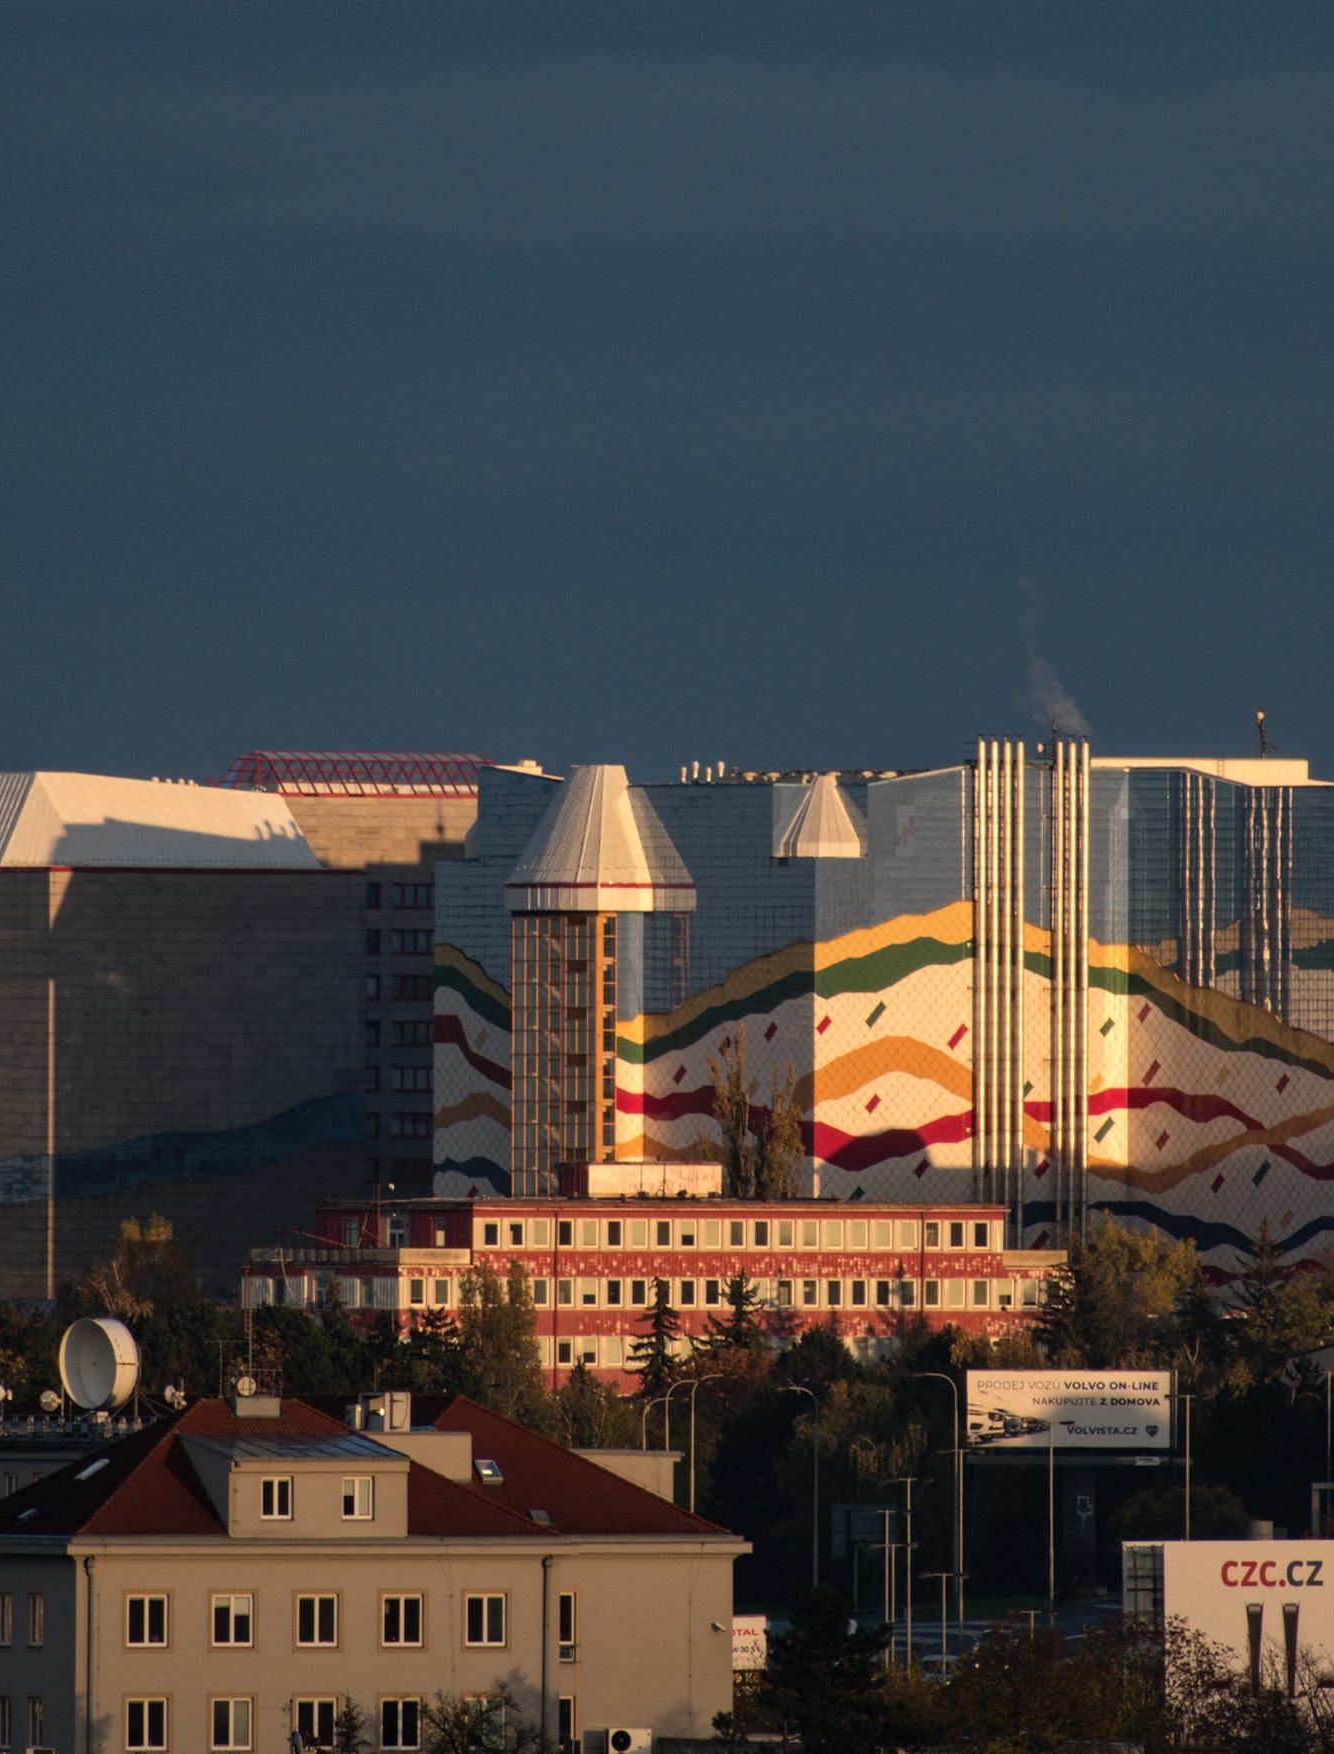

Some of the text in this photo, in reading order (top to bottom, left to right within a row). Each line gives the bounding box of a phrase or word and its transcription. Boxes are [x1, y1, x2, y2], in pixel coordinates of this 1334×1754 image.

[977, 1378, 1159, 1391] PRODEJ VOZŮ VOLVO ON-LINE
[1032, 1397, 1160, 1407] NAKUPUJTE Z DOMOVA
[1066, 1426, 1138, 1436] VOLVISTA.CZ
[1220, 1560, 1324, 1588] CZC.CZ
